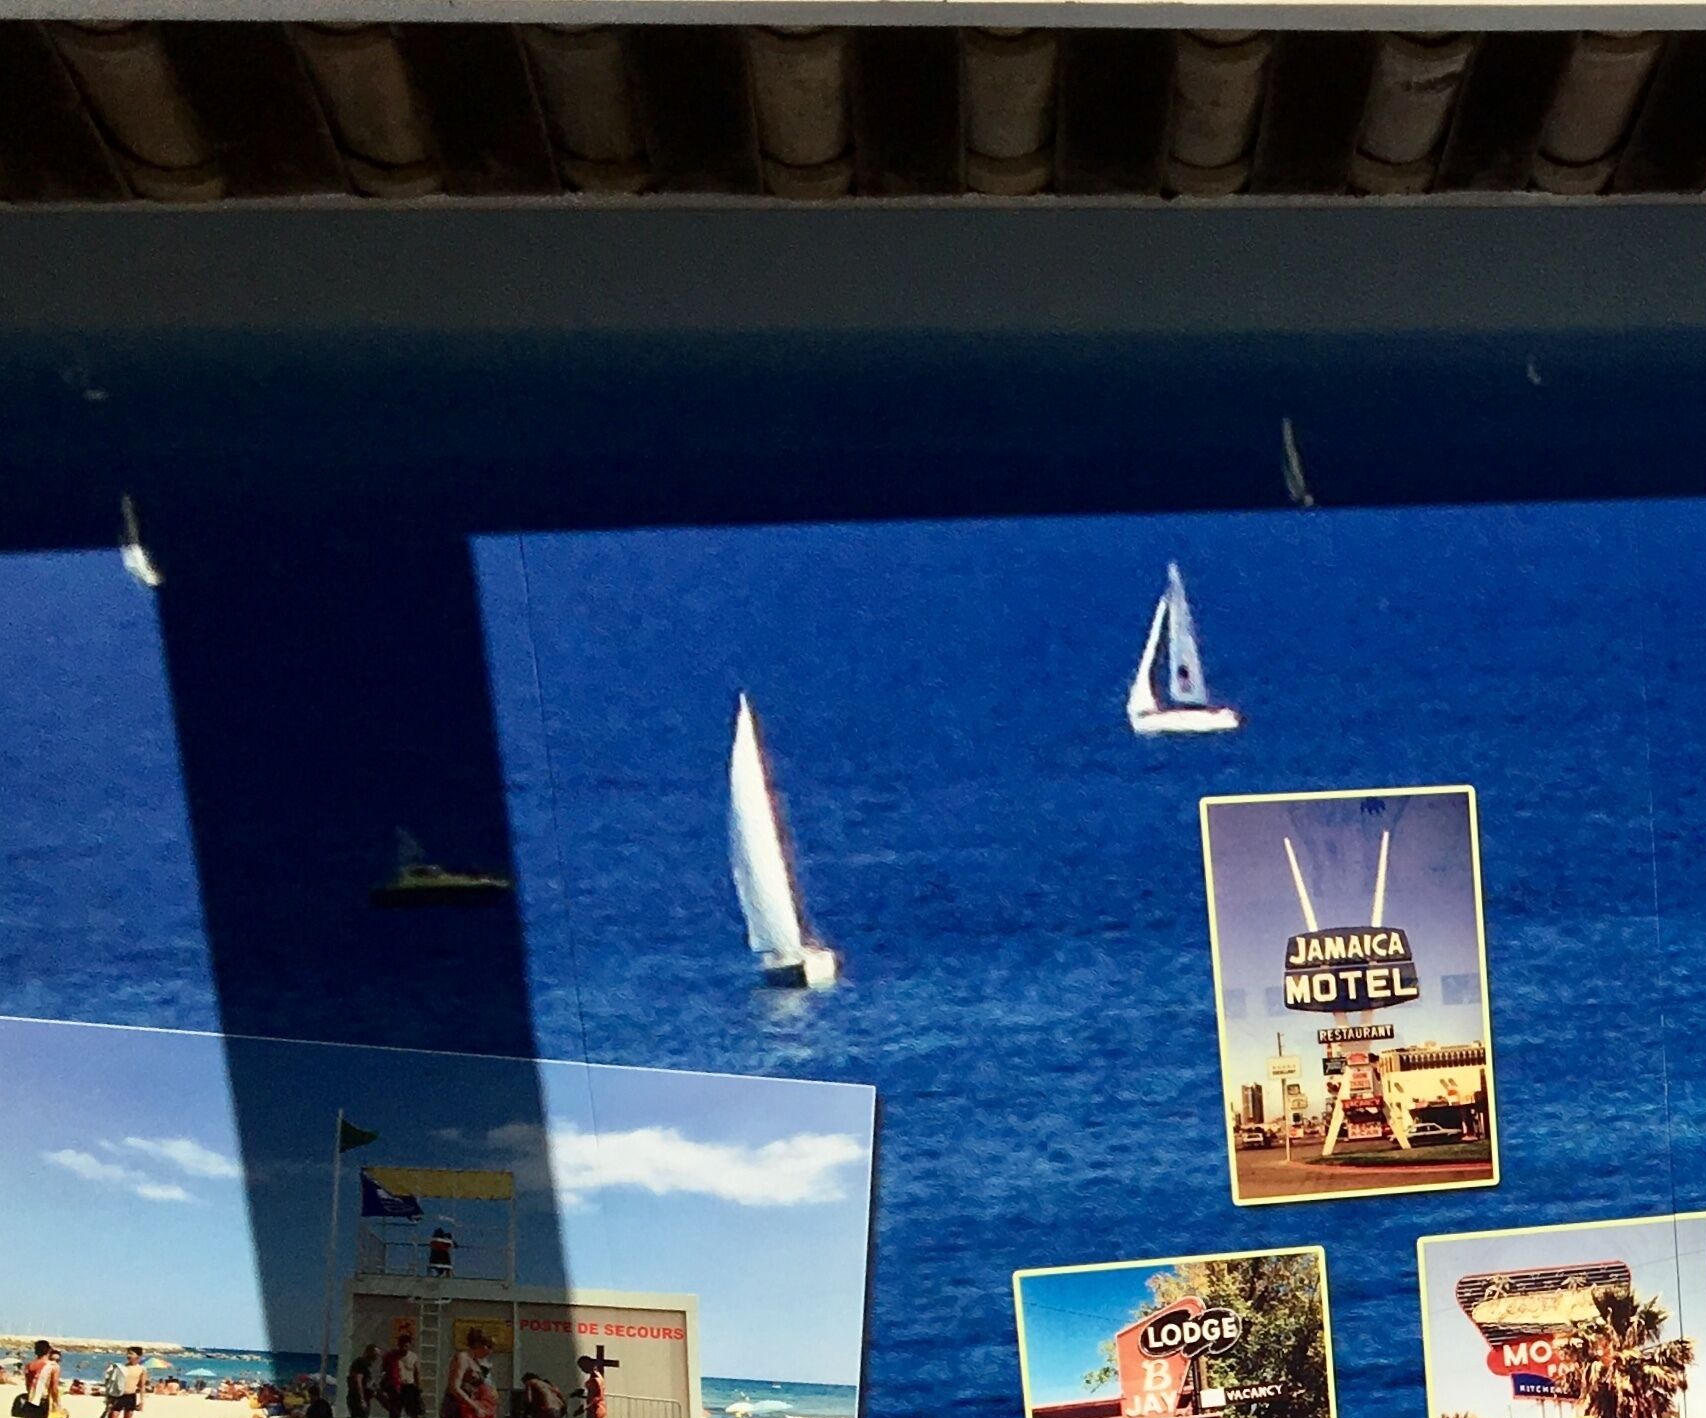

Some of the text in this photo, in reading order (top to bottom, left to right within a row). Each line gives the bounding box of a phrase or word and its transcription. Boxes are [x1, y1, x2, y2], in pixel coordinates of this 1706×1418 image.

[1289, 933, 1405, 965] JAMAICA
[1285, 968, 1417, 1005] MOTEL
[1319, 1025, 1393, 1042] RESTAURANT
[520, 1320, 684, 1340] POSTE DE SECOURS
[1148, 1318, 1237, 1348] LODGE
[1141, 1359, 1172, 1391] B
[1126, 1391, 1178, 1417] JAY
[1227, 1384, 1283, 1401] VACANCY
